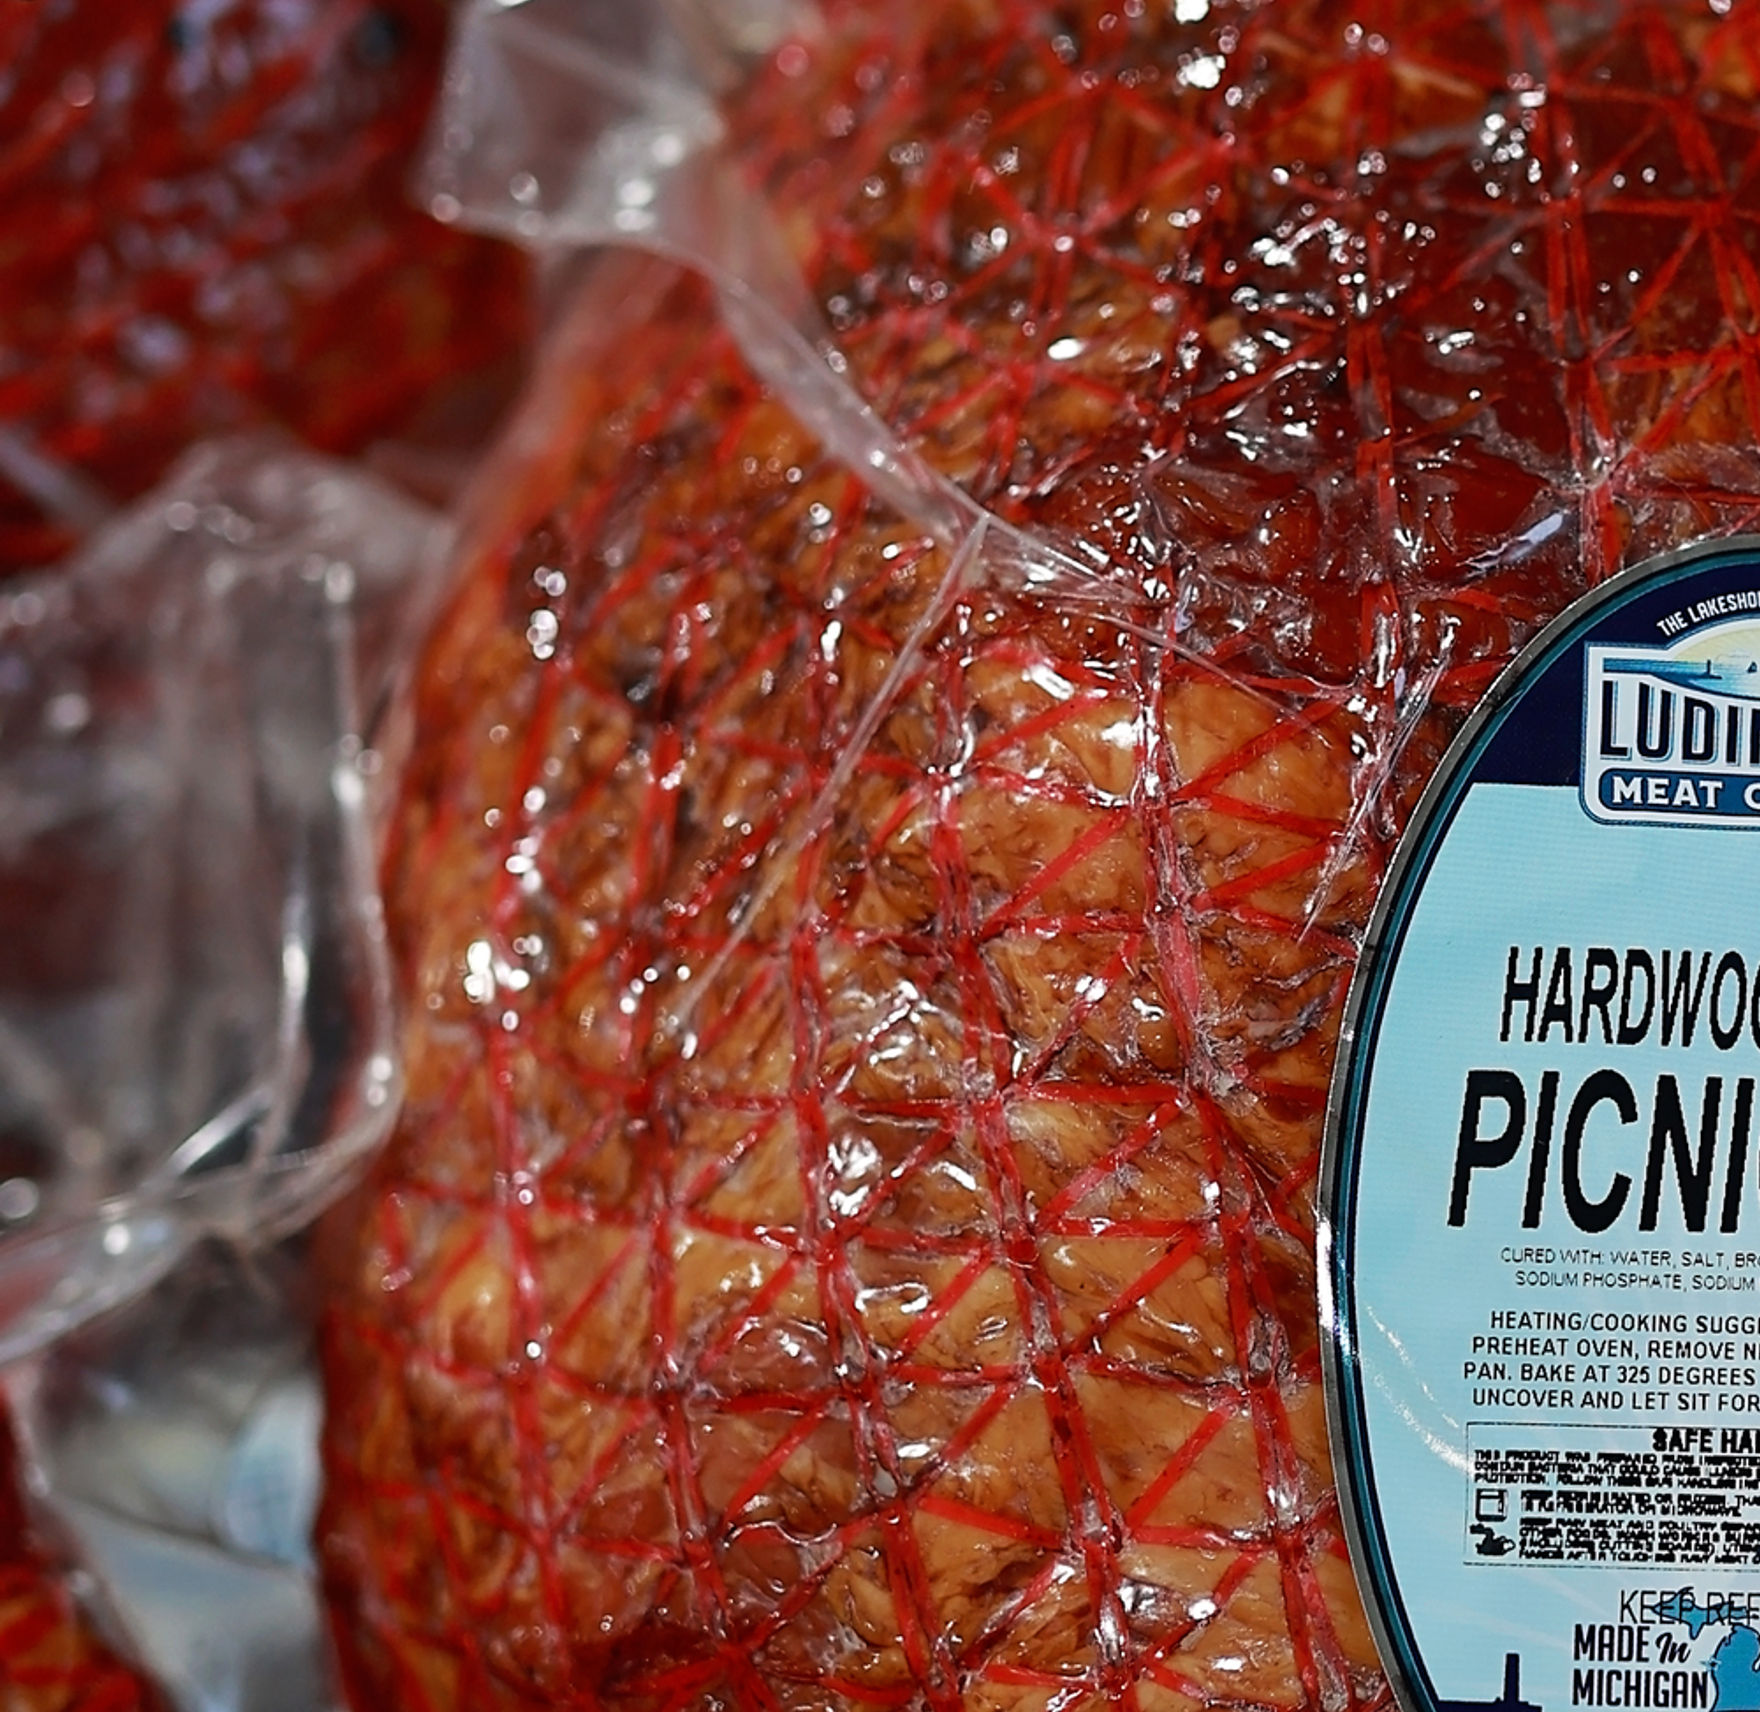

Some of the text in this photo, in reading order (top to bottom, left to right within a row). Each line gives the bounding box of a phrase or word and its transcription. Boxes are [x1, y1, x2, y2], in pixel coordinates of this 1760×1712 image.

[1656, 611, 1688, 637] THE
[1611, 776, 1723, 809] MEAT
[1501, 1247, 1556, 1264] CURED
[1560, 1249, 1605, 1265] WITH:
[1610, 1250, 1677, 1268] WATER,
[1681, 1252, 1729, 1270] SALT,
[1515, 1271, 1579, 1287] SODIUM
[1583, 1273, 1687, 1292] PHOSPHATE,
[1692, 1274, 1755, 1291] SODIUM
[1490, 1311, 1687, 1332] HEATING/COOKING
[1472, 1336, 1569, 1356] PREHEAT
[1576, 1338, 1639, 1360] OVEN,
[1648, 1340, 1735, 1360] REMOVE
[1464, 1362, 1512, 1381] PAN.
[1521, 1363, 1575, 1382] BAKE
[1583, 1365, 1610, 1383] AT
[1617, 1365, 1650, 1384] 325
[1658, 1366, 1755, 1386] DEGREES
[1472, 1388, 1574, 1408] UNCOVER
[1581, 1390, 1623, 1410] AND
[1632, 1392, 1670, 1410] LET
[1678, 1393, 1710, 1412] SIT
[1718, 1394, 1760, 1412] FOR
[1653, 1428, 1713, 1453] SAFE
[1574, 1623, 1690, 1664] MADE In
[1572, 1668, 1708, 1708] MICHIGAN
